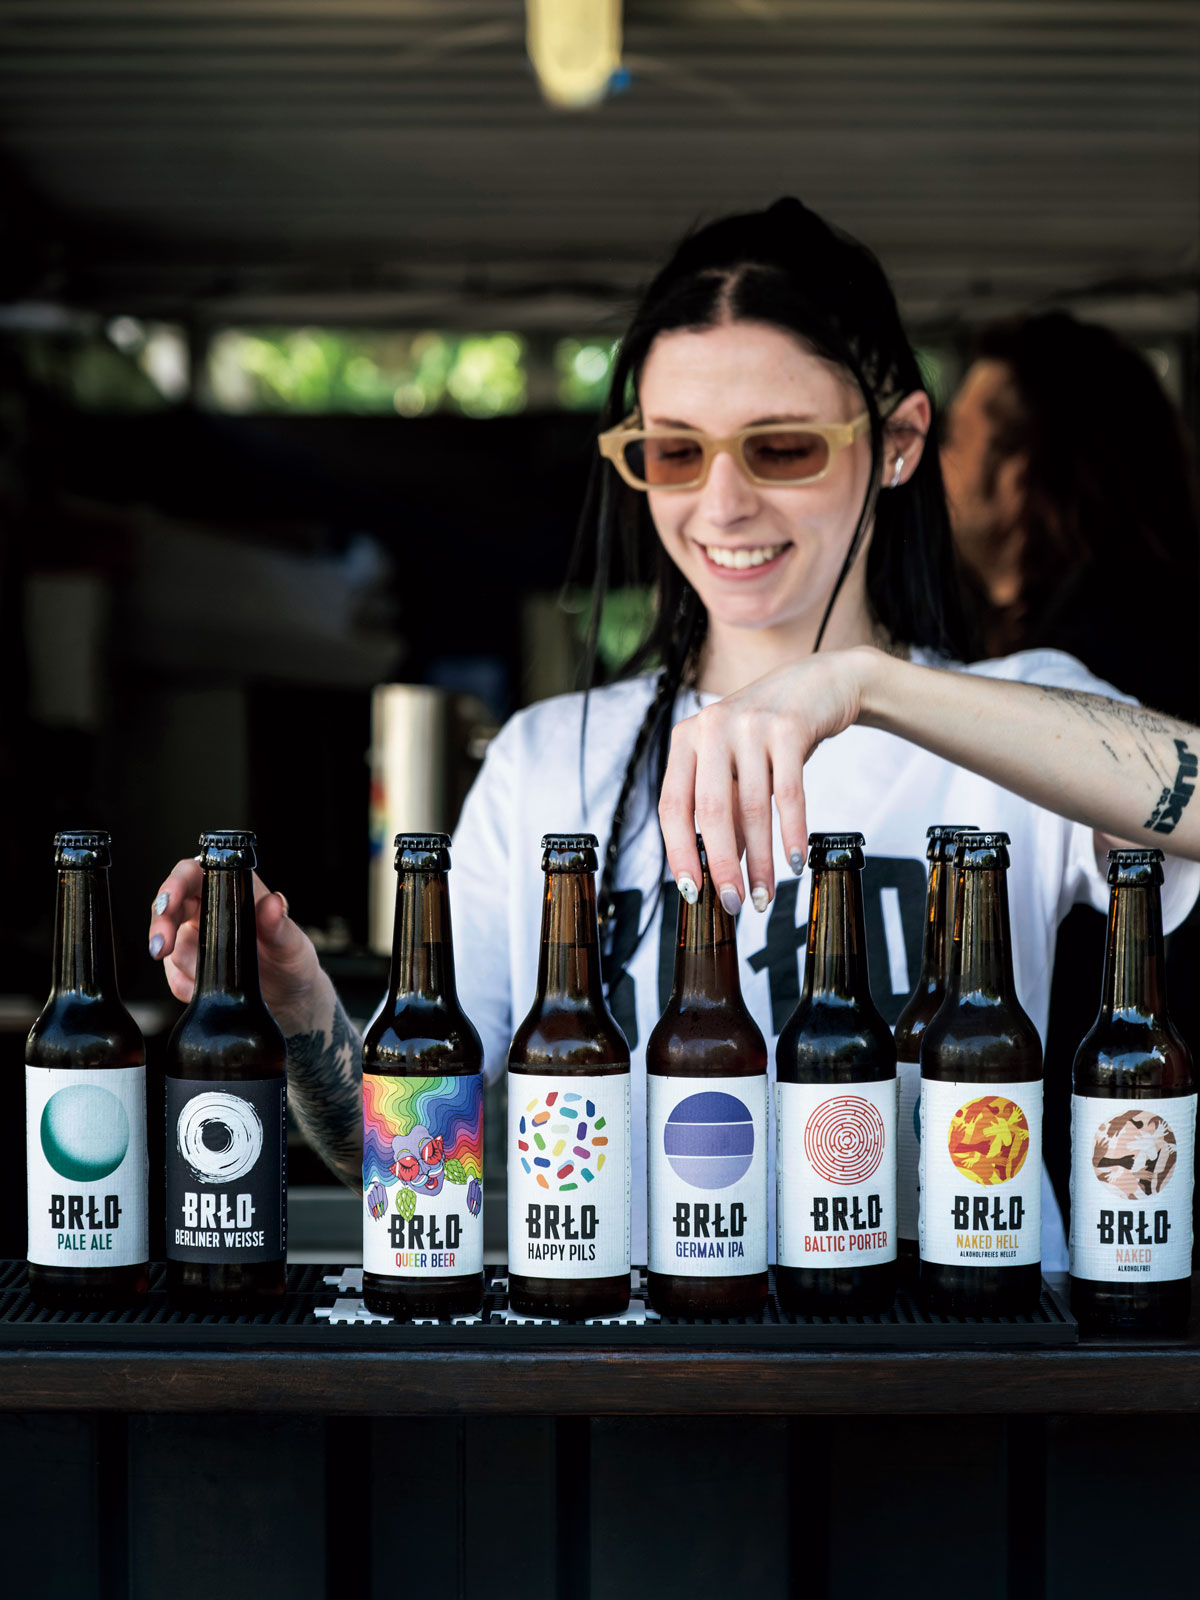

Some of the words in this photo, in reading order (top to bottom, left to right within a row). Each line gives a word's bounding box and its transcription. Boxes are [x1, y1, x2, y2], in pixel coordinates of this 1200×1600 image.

[1152, 738, 1199, 834] JUKI
[57, 1232, 87, 1251] PALE
[89, 1232, 113, 1250] ALE
[174, 1228, 220, 1248] BERLINER
[224, 1230, 265, 1248] WEISSE
[804, 1235, 846, 1253] BALTIC
[849, 1231, 888, 1251] PORTER
[956, 1234, 992, 1250] NAKED
[996, 1234, 1020, 1249] HELL
[527, 1242, 566, 1262] HAPPY
[569, 1243, 596, 1262] PILS
[675, 1241, 725, 1259] GERMAN
[728, 1241, 745, 1258] IPA
[960, 1250, 999, 1258] ALKOHOLFREIES
[1000, 1250, 1017, 1258] HELLES
[1115, 1249, 1152, 1263] NAKED
[395, 1252, 428, 1268] QUEER
[431, 1252, 456, 1268] BEER
[1117, 1264, 1151, 1272] ALKOHOLFREI
